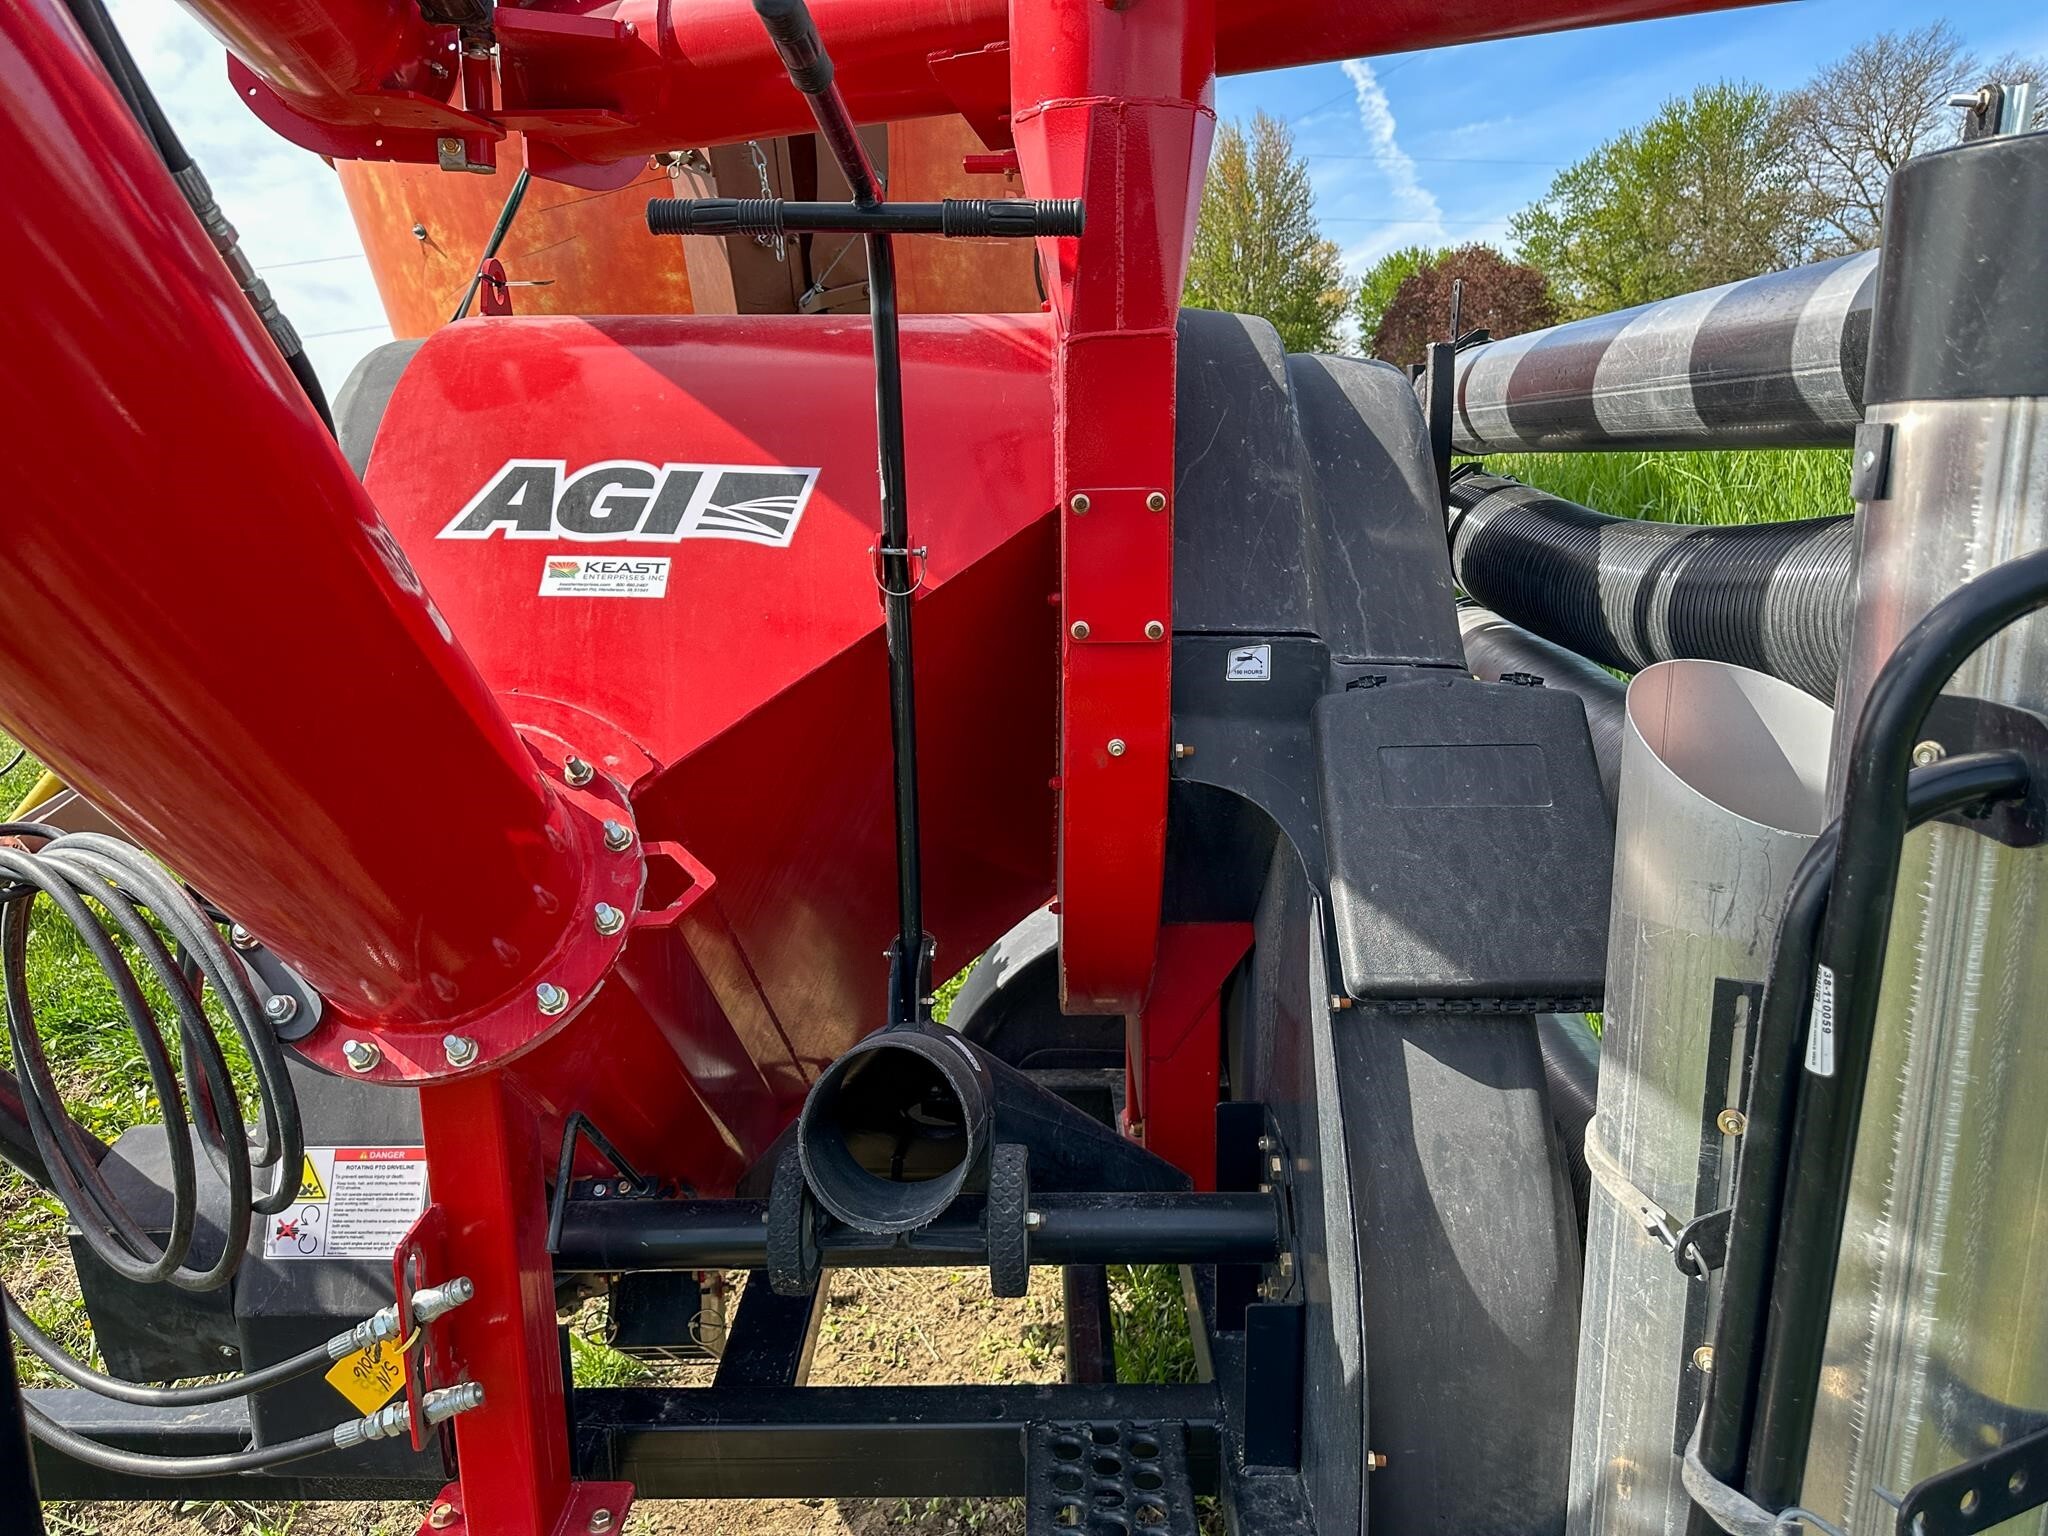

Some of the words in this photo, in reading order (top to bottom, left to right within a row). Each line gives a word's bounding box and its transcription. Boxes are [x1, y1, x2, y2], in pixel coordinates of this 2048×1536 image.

[450, 464, 706, 536] AGI
[584, 561, 667, 574] KEAST
[1822, 972, 1832, 1034] 38-110059
[376, 1360, 399, 1392] S/N
